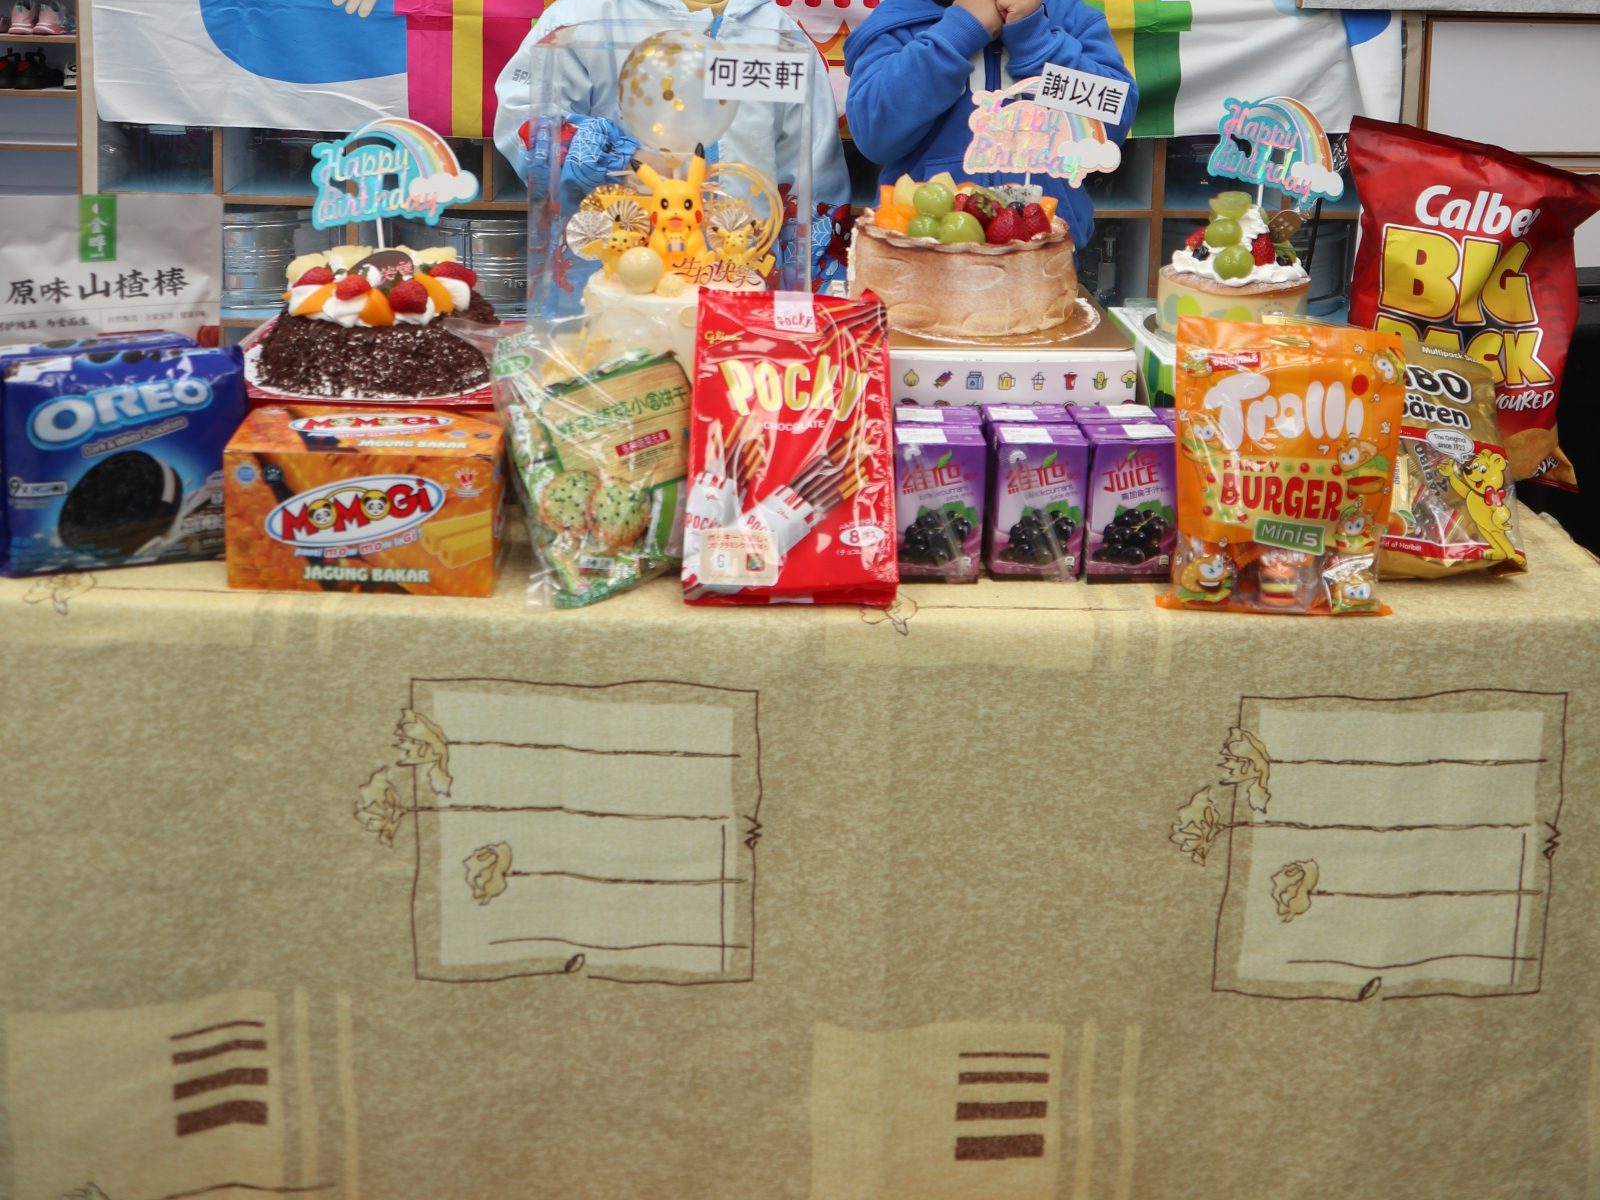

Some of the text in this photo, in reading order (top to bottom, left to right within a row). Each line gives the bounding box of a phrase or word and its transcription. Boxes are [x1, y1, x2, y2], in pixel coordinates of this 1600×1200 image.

[709, 57, 806, 91] 何奕軒
[1042, 72, 1124, 115] 謝以信
[975, 98, 1062, 133] Happy
[1223, 104, 1299, 150] Happy
[320, 146, 411, 182] Happy
[967, 130, 1082, 183] Birthday
[1213, 141, 1313, 203] Birthday
[317, 168, 439, 223] Birthday
[7, 266, 190, 306] 原味山楂棒
[1379, 223, 1538, 325] BIG
[1422, 345, 1464, 360] Multipack
[33, 378, 209, 443] OREO
[763, 420, 826, 432] CHOCOLATE
[1203, 372, 1370, 450] Trolli
[357, 439, 468, 449] JAGUNG BAKAR
[1438, 442, 1466, 451] since 1922
[1445, 434, 1467, 443] Original
[1103, 465, 1160, 493] JUICE
[1223, 460, 1281, 473] PARTY
[1220, 473, 1344, 522] BURGER
[1261, 523, 1319, 548] Minis
[304, 565, 430, 583] JAGUNG BAKAR
